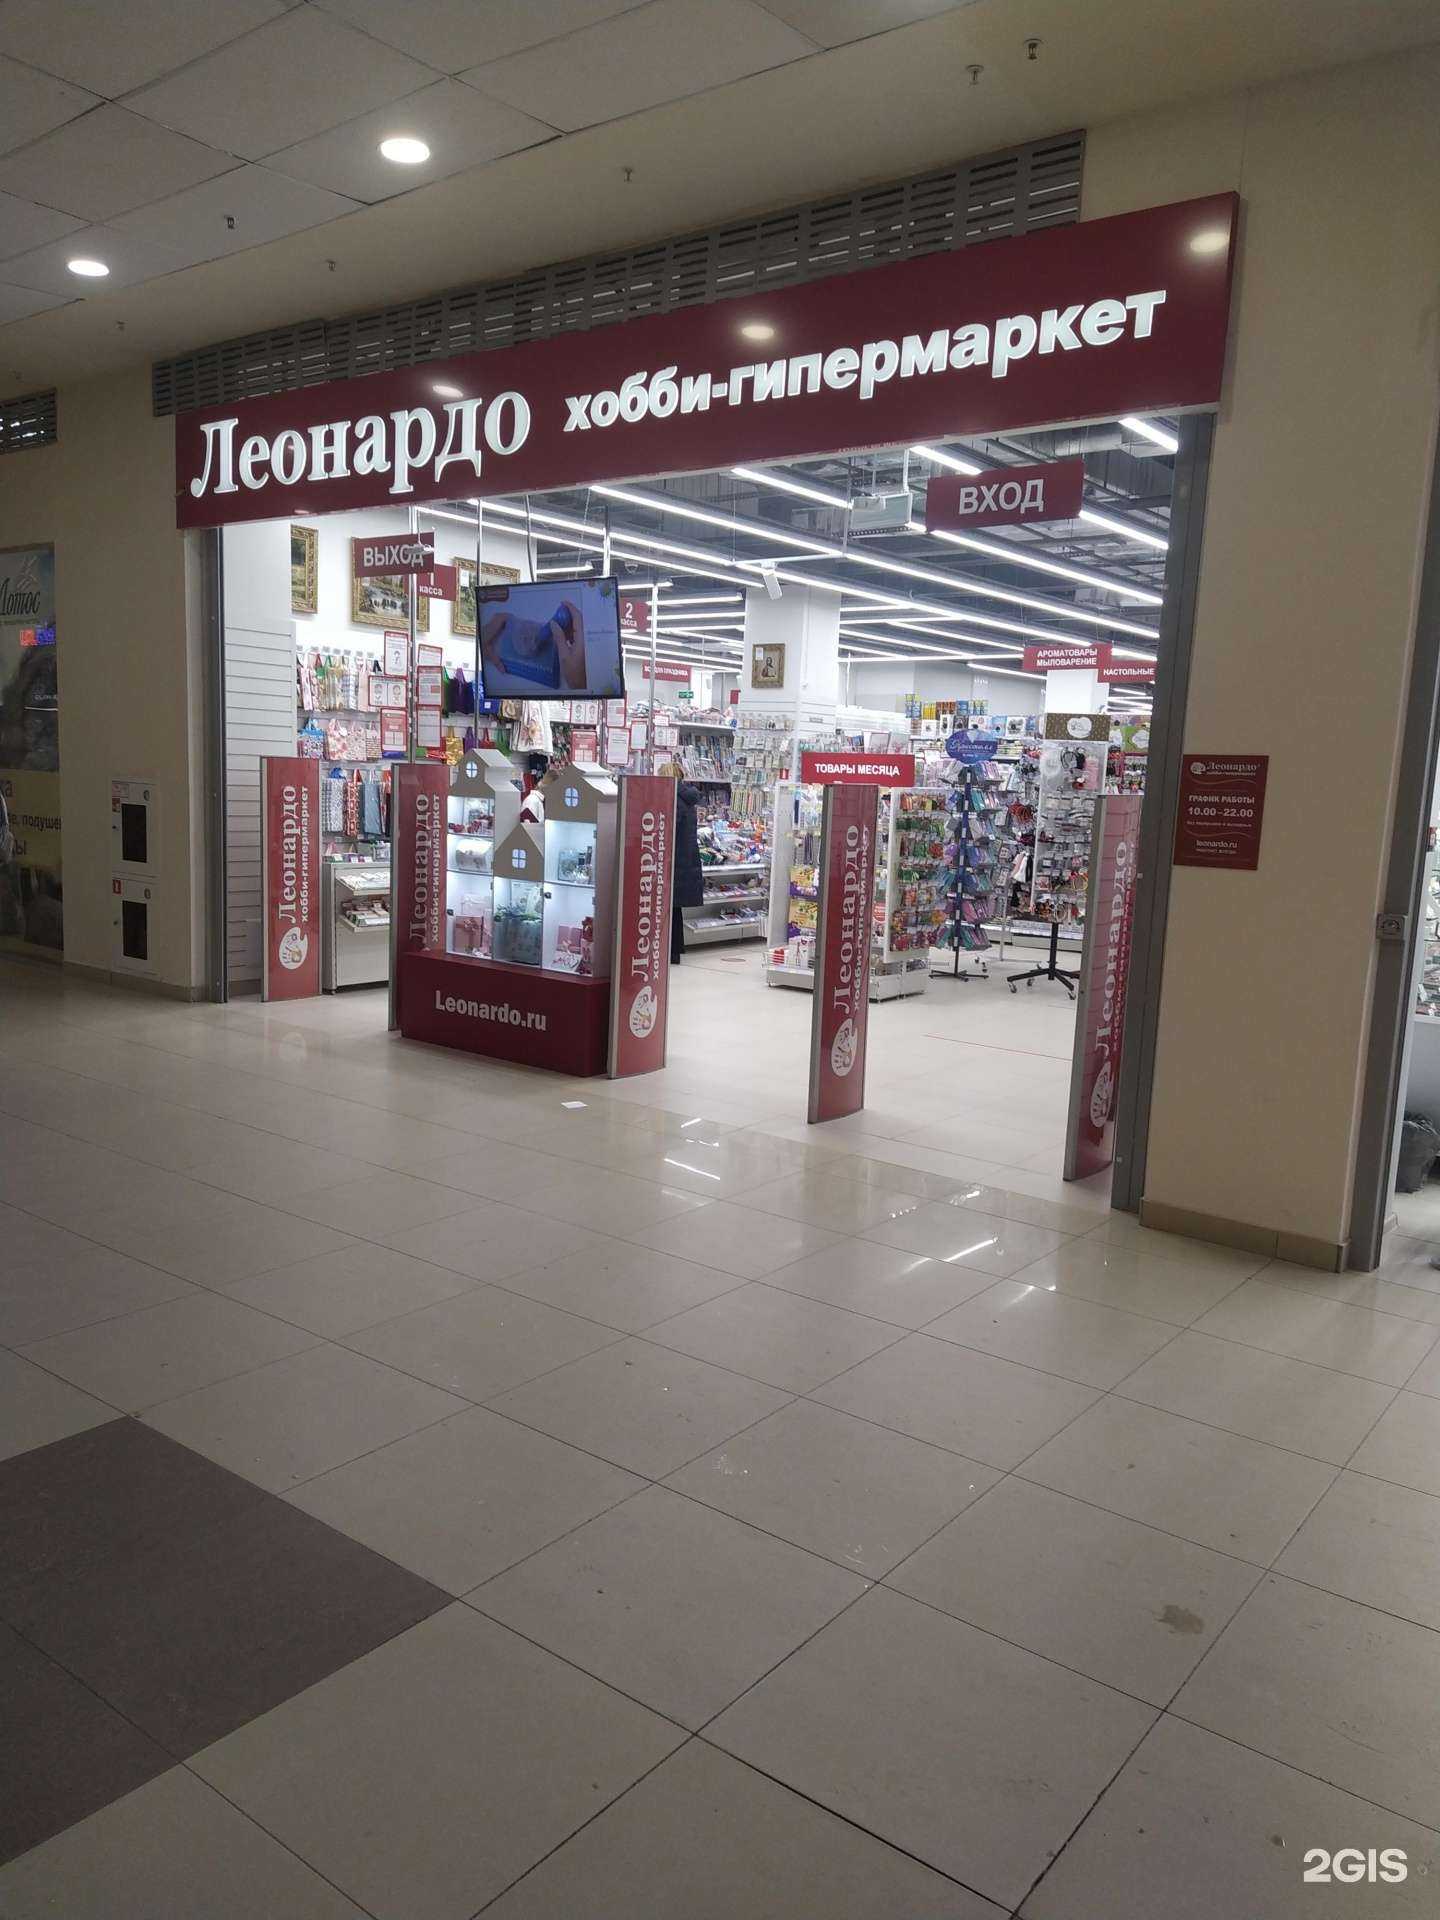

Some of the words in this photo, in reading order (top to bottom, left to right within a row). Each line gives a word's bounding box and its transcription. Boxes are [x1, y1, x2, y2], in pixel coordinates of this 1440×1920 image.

[190, 391, 531, 498] Леонардо
[563, 289, 1167, 432] хобби-гипермаркет
[959, 479, 1044, 514] ВХОД
[363, 544, 424, 568] ВЫХОД
[419, 585, 443, 597] касса
[625, 602, 633, 618] 2
[1036, 657, 1097, 666] МЫЛОВАРЕНИЕ
[1037, 648, 1097, 657] АРОМАТОВАРЫ
[1103, 668, 1155, 676] НАСТОЛЬНЫЕ
[815, 764, 856, 774] ТОВАРЫ
[858, 765, 900, 777] МЕСЯЦА
[1189, 795, 1219, 803] ГРАФИК
[1221, 796, 1255, 804] РАБОТЫ
[279, 785, 301, 924] Леонардо
[300, 786, 309, 922] хобби-гипермаркет
[409, 794, 431, 946] Леонардо
[631, 811, 657, 982] Леонардо
[833, 825, 861, 1014] Леонардо
[1095, 841, 1127, 1060] Леонардо
[435, 990, 547, 1031] Leonardo.ru
